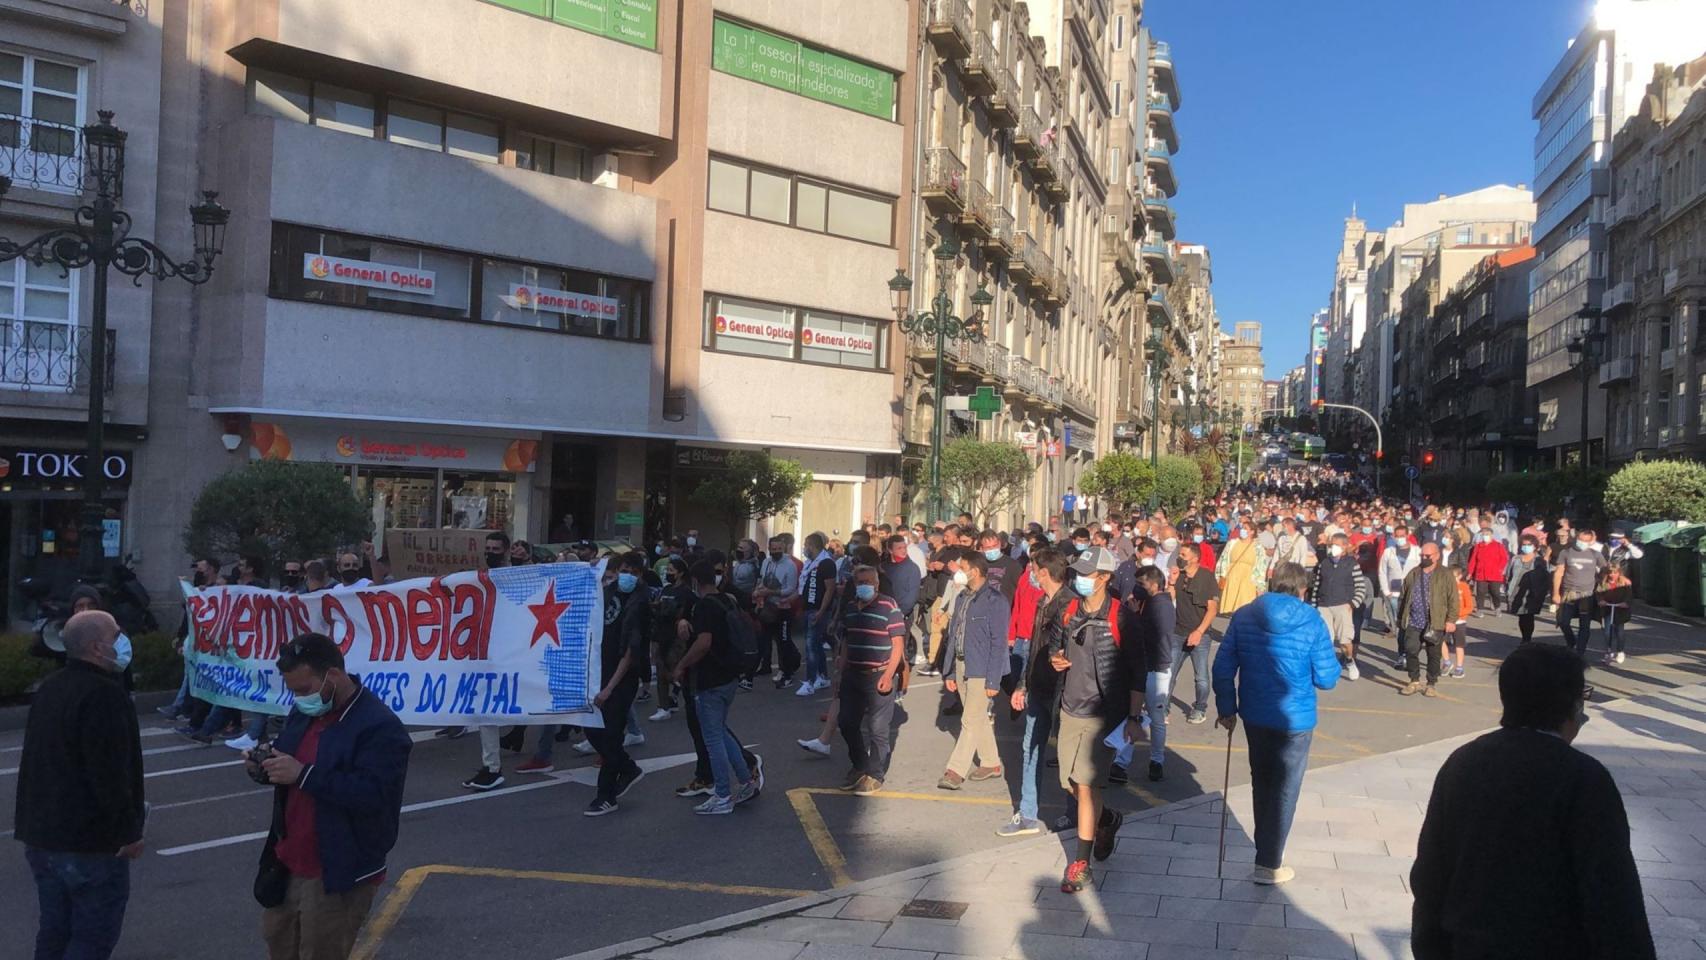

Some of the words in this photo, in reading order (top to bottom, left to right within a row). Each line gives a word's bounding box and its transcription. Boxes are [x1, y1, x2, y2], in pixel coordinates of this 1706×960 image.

[621, 11, 641, 23] Fiscal
[620, 24, 647, 39] Laboral
[723, 28, 736, 47] La
[751, 61, 766, 74] en
[333, 263, 386, 283] General
[390, 271, 433, 289] Optica
[536, 292, 578, 309] General
[729, 320, 764, 336] General
[766, 325, 794, 340] Optica
[814, 332, 846, 346] General
[847, 337, 873, 351] Optica
[16, 452, 127, 479] TOKO
[356, 567, 497, 662] metal
[413, 672, 447, 713] DO
[448, 672, 522, 714] METAL
